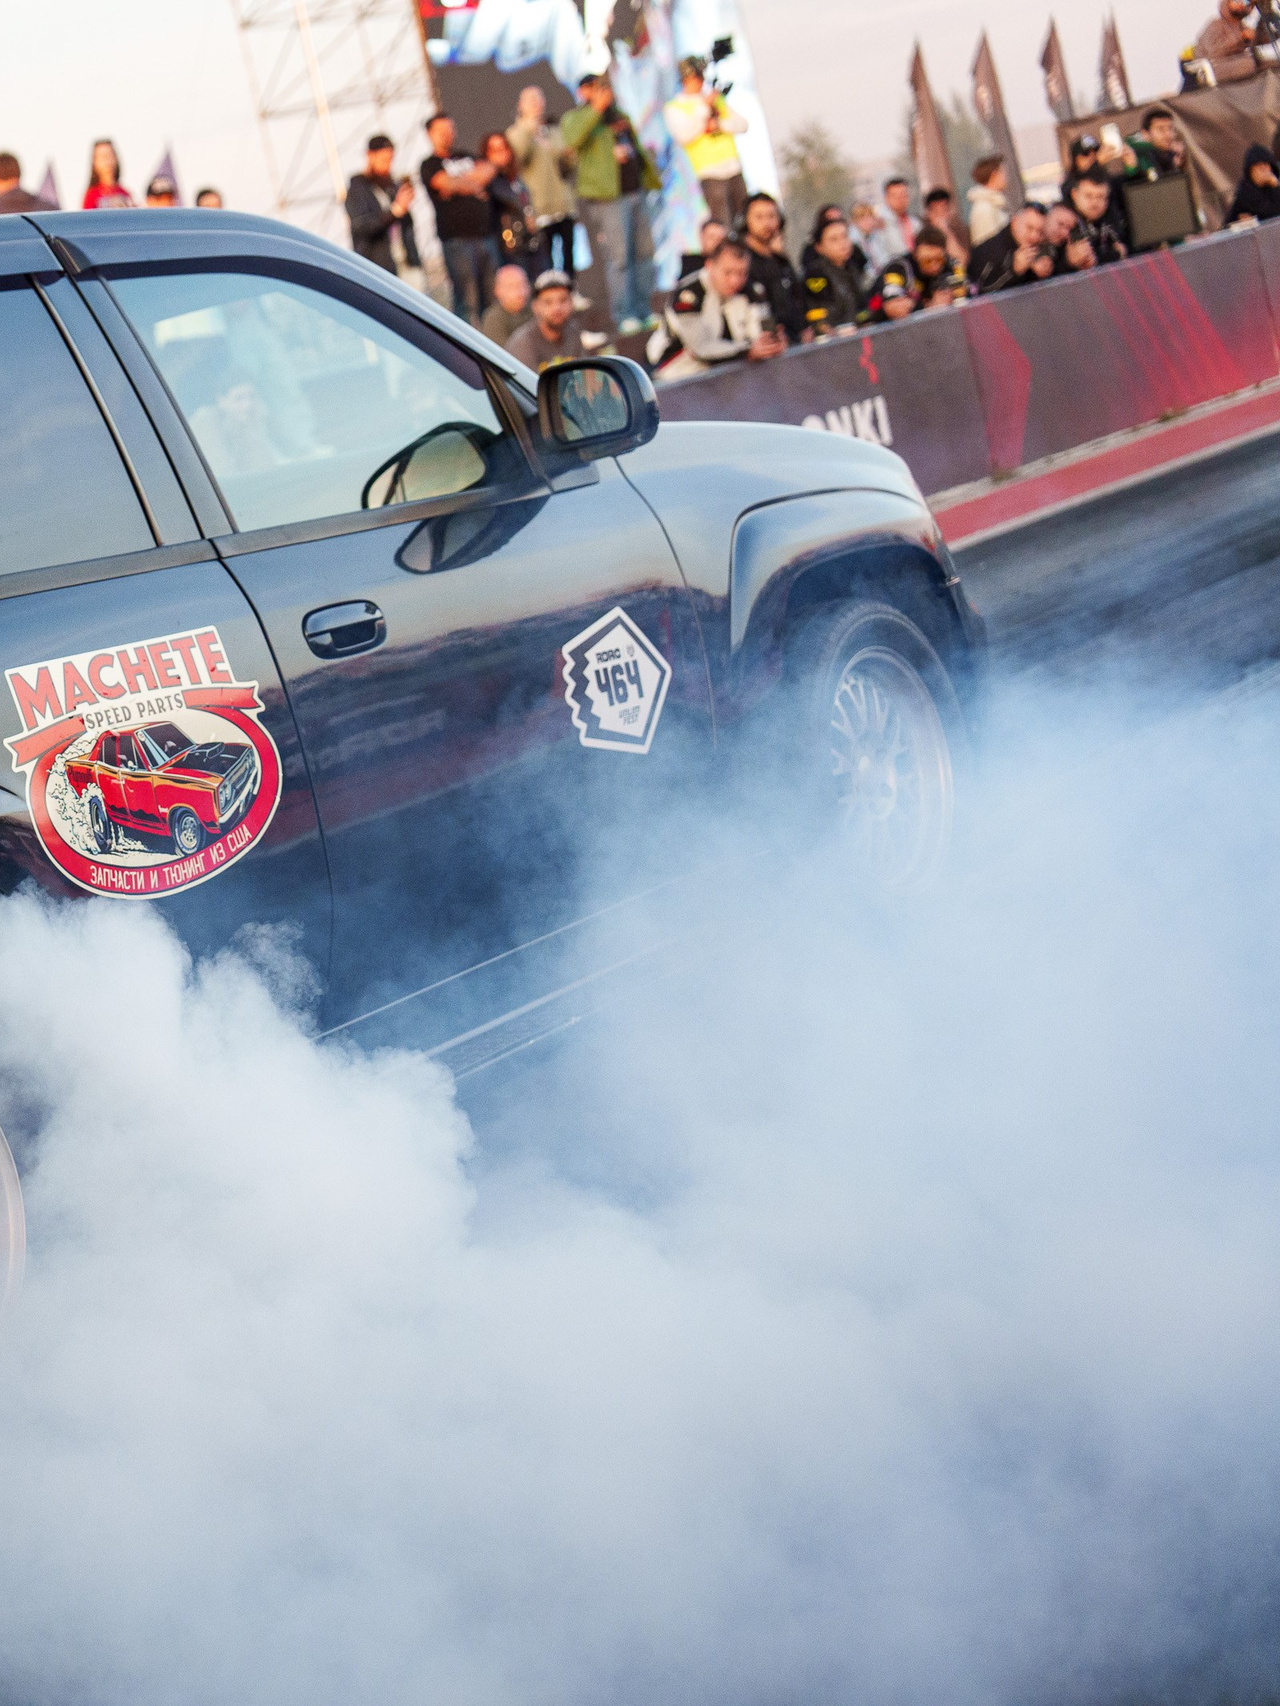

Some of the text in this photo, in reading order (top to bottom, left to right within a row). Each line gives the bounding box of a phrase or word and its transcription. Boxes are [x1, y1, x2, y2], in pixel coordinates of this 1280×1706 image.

[10, 631, 232, 730] MACHETE
[594, 659, 644, 707] 464
[85, 693, 184, 730] SPEED PARTS
[90, 824, 253, 890] ЗАПЧАСТИ И ТЮНИНГ ИЗ США
